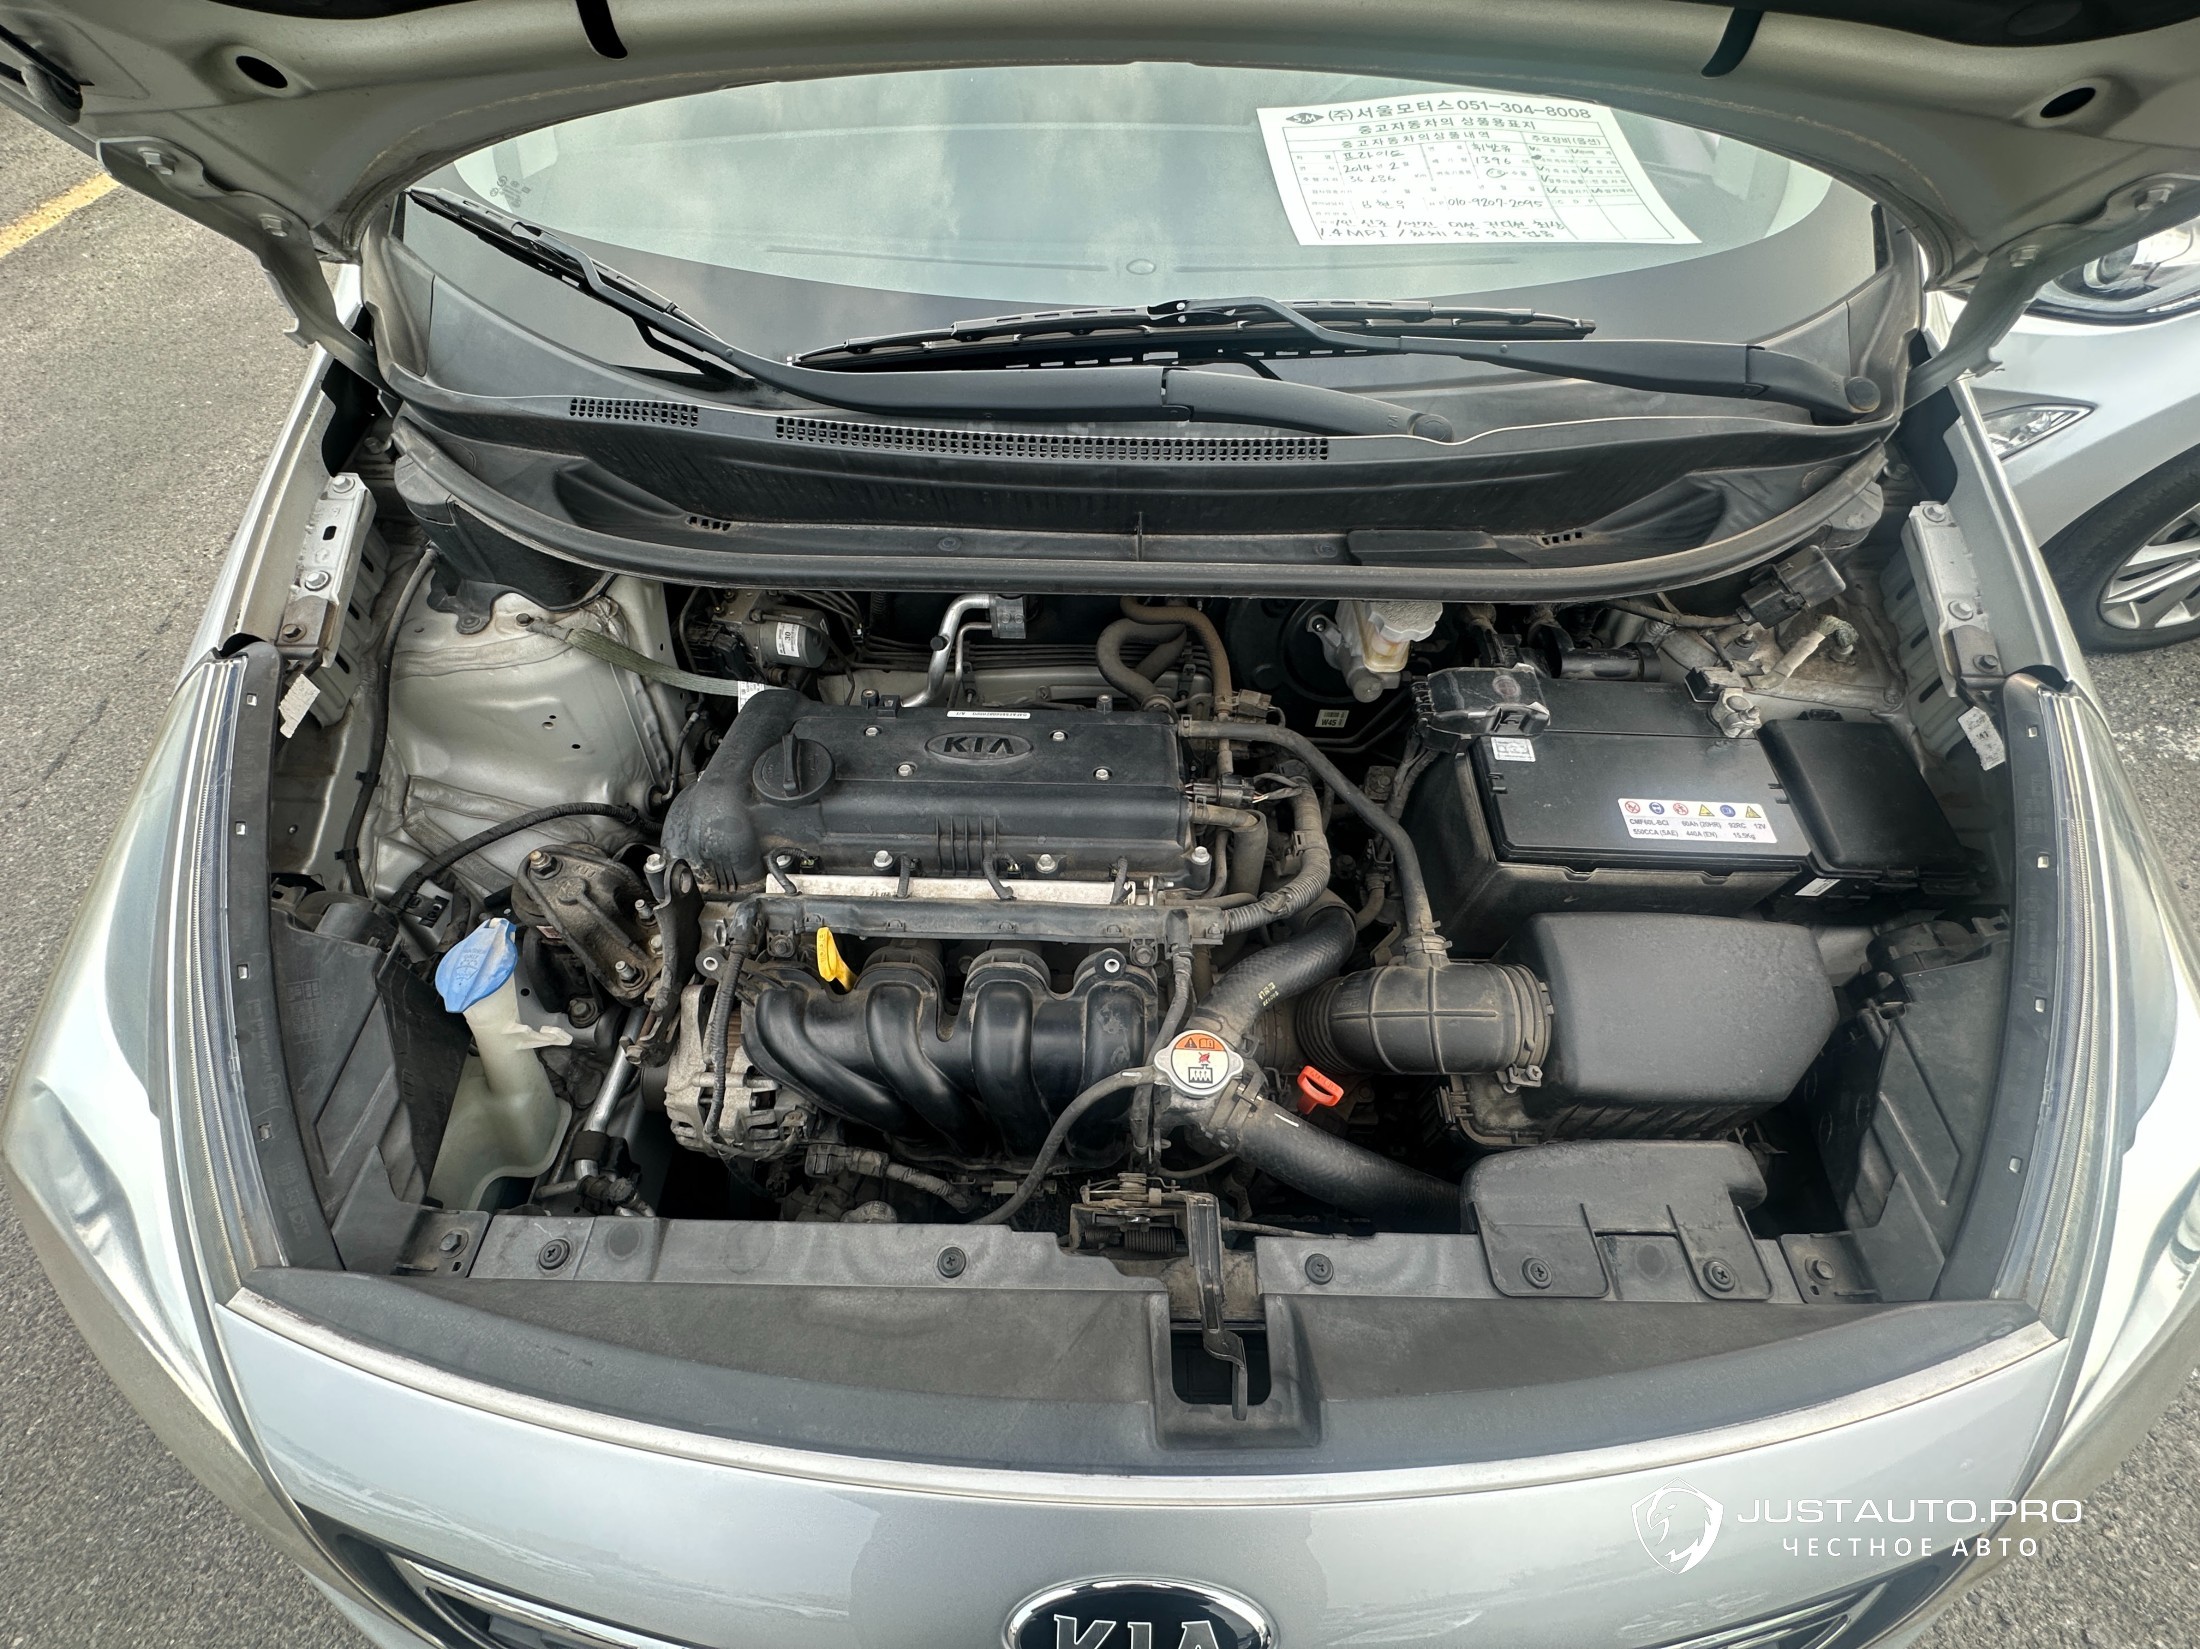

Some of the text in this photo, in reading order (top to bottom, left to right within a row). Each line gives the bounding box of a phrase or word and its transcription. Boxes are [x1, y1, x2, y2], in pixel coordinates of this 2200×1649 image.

[1457, 99, 1591, 119] 051-304-8008
[1475, 156, 1512, 165] 1396
[1343, 163, 1372, 173] 2014
[1389, 161, 1400, 171] 2
[944, 737, 1014, 754] KIA
